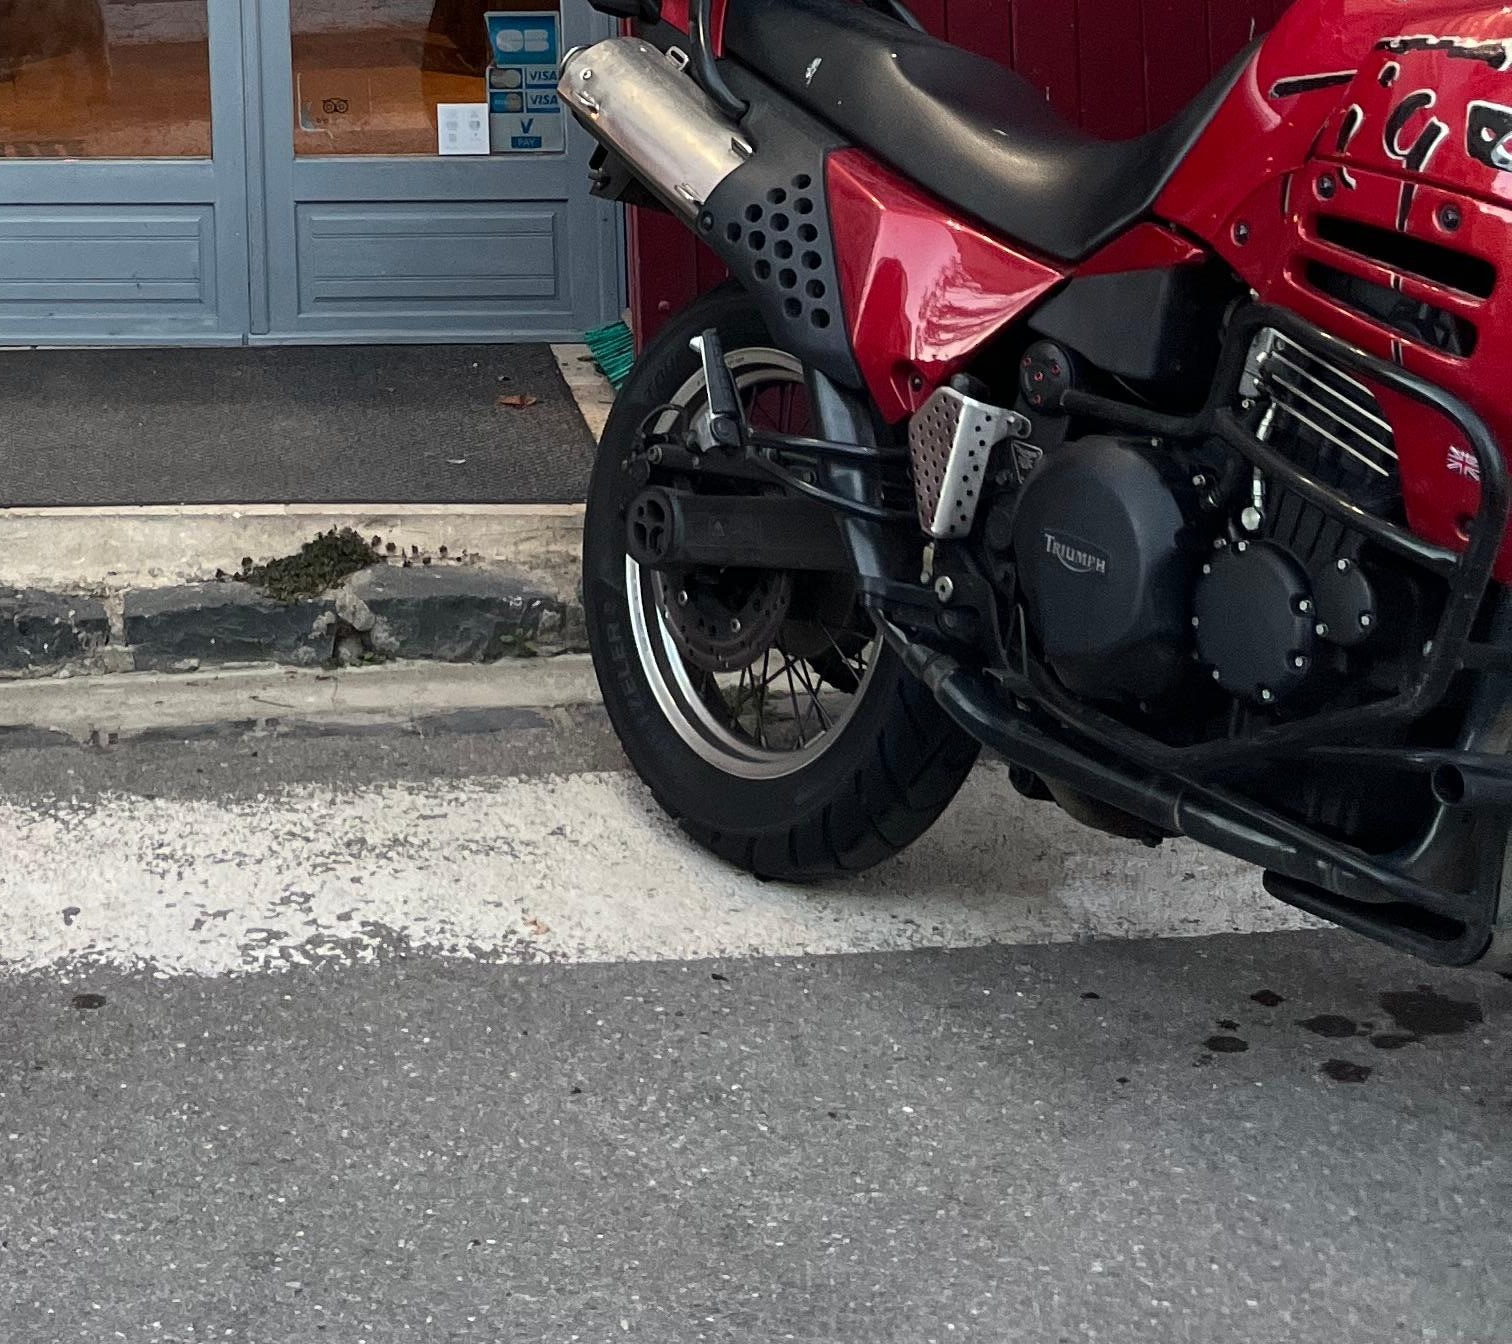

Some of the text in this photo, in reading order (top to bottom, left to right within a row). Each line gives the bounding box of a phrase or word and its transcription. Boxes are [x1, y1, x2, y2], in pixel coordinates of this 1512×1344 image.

[530, 71, 558, 81] VISA
[530, 94, 559, 105] VISA
[1044, 532, 1106, 574] TRIUMPH
